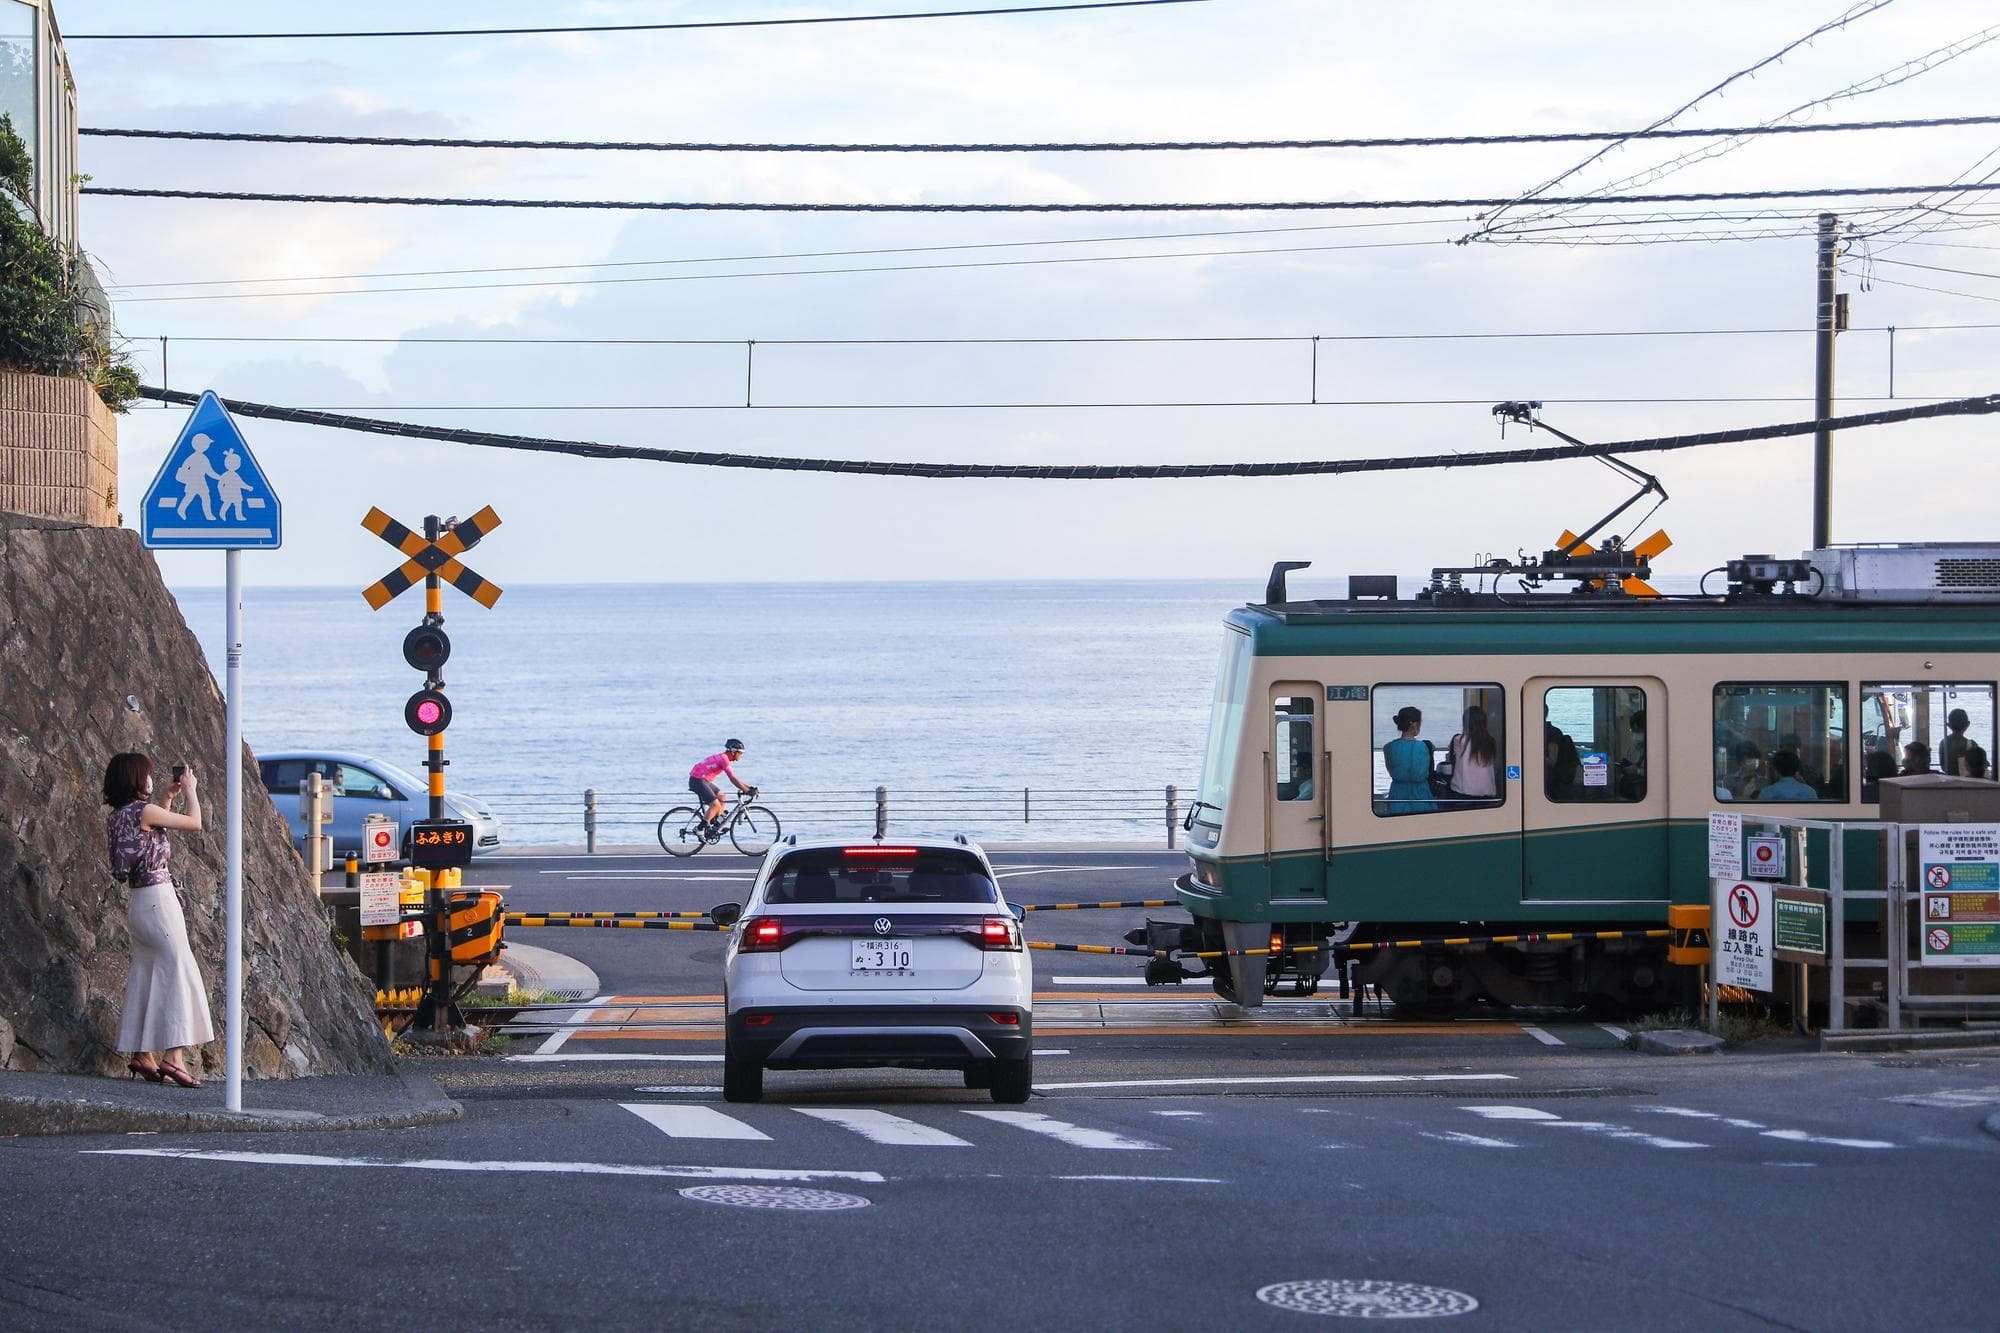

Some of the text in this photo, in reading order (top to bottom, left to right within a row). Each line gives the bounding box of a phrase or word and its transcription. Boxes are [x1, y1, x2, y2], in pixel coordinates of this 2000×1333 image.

[416, 831, 465, 845] ふみきり
[467, 928, 473, 937] 2
[1728, 928, 1758, 943] 線路内
[1695, 934, 1701, 943] 3
[1722, 940, 1764, 958] 立入禁止
[1733, 955, 1755, 964] Keep Out
